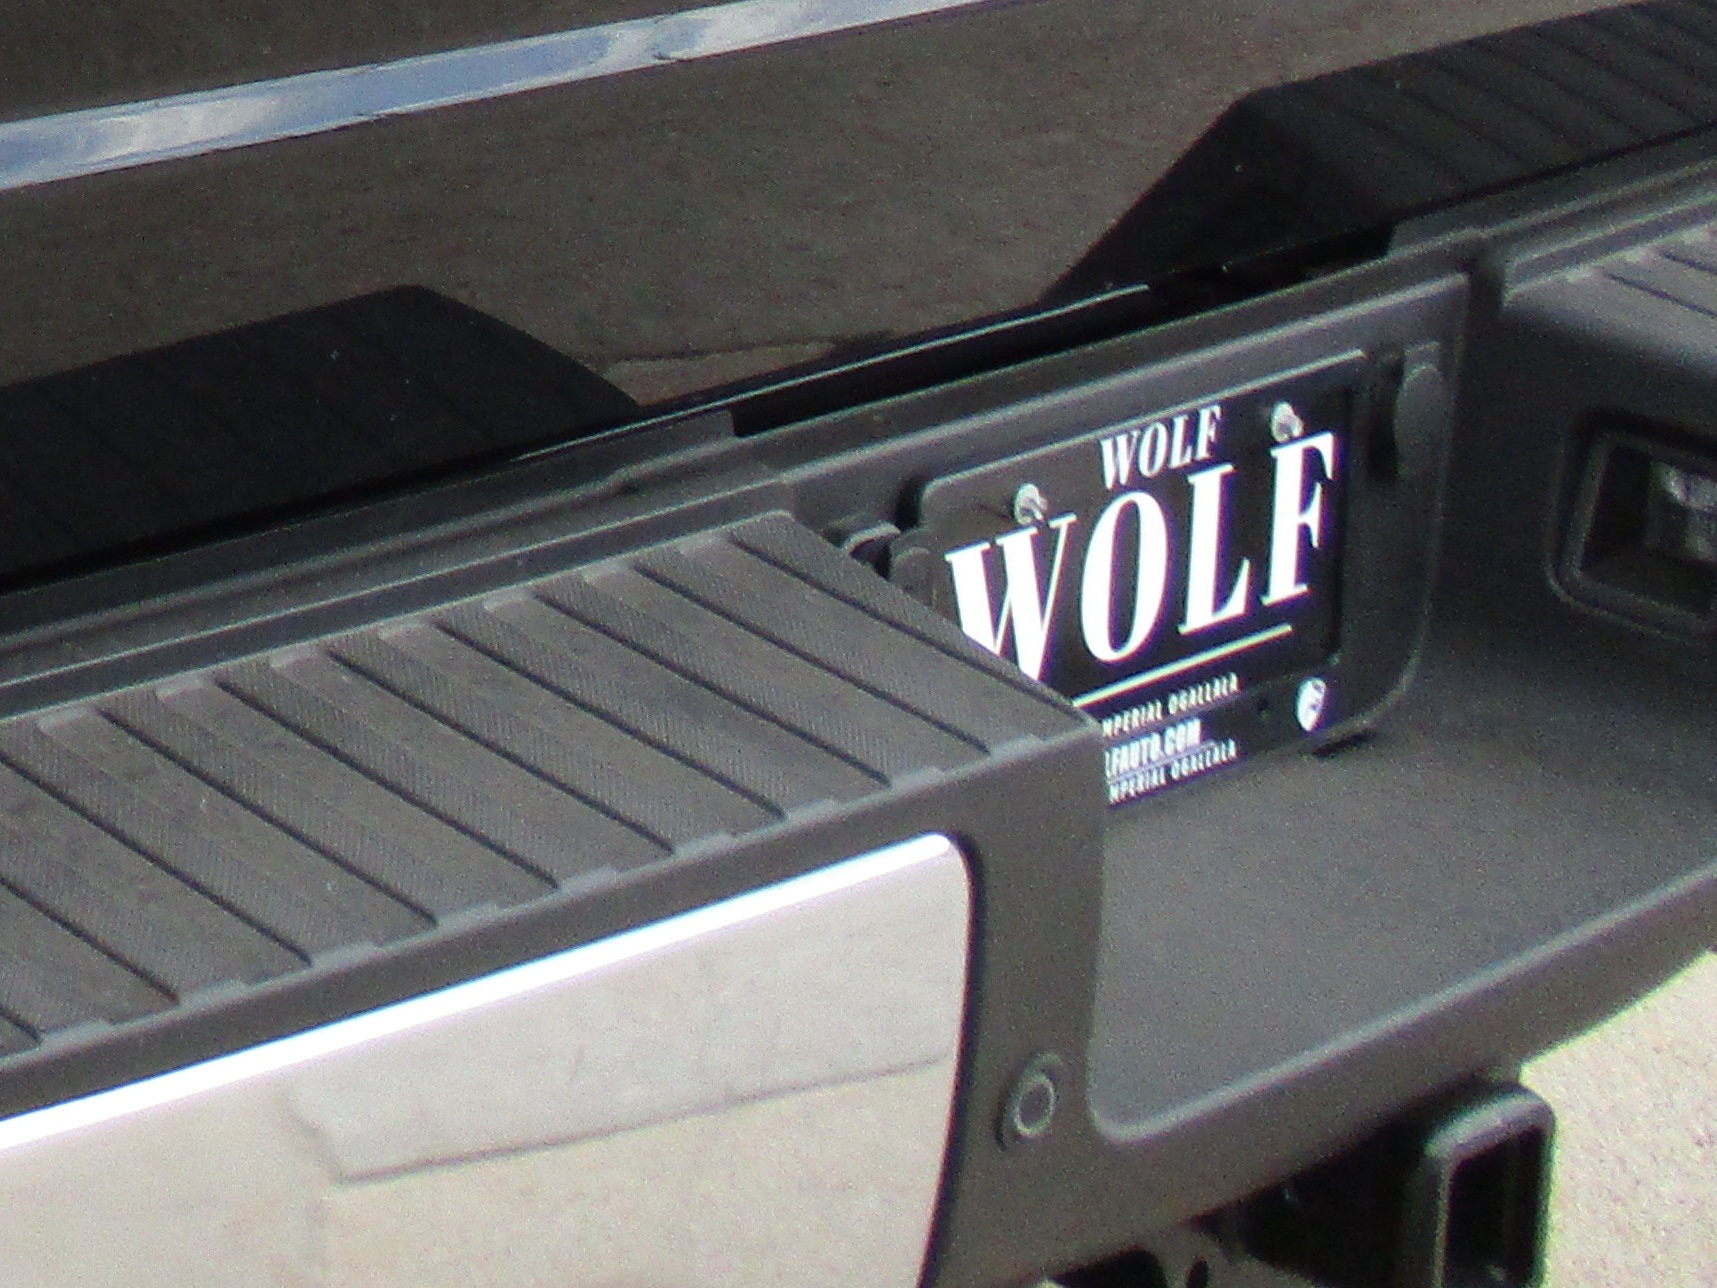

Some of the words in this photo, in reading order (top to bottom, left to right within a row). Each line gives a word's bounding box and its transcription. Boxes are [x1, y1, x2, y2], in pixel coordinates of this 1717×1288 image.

[1099, 405, 1222, 489] WOLF
[945, 431, 1335, 682] WOLF
[1102, 699, 1164, 738] MPERIAL
